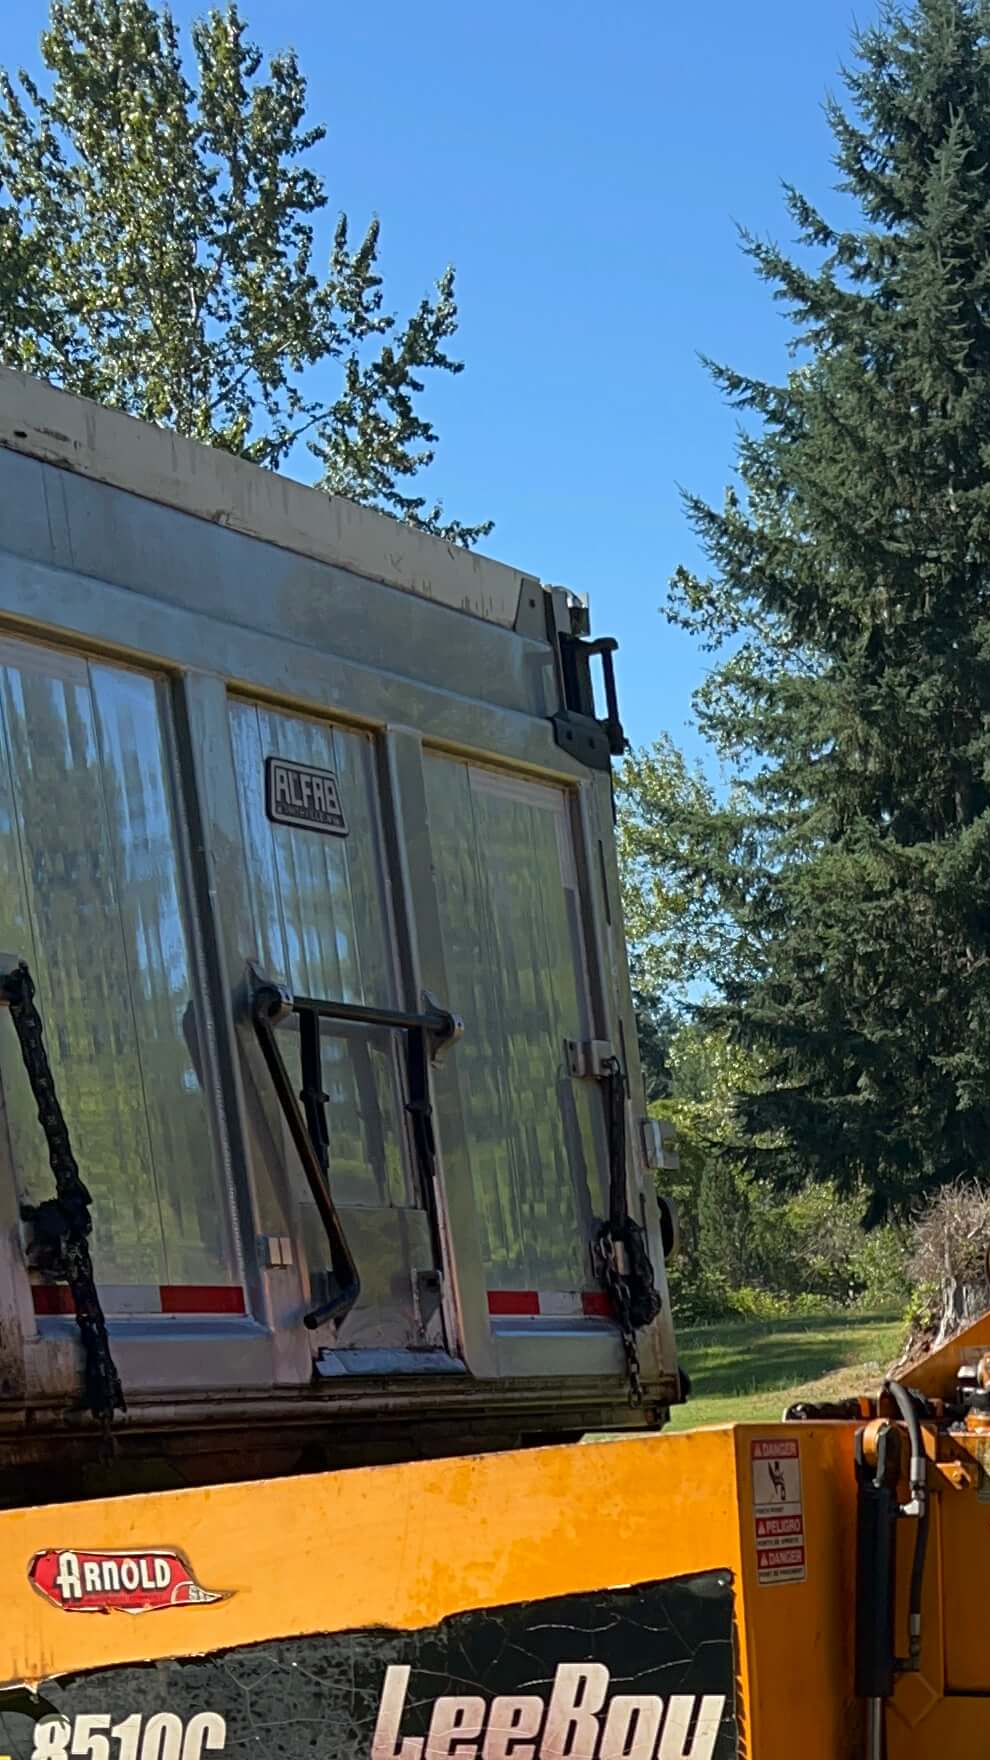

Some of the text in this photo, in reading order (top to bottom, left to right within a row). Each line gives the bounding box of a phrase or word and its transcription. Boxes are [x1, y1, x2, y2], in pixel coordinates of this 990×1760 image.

[275, 767, 341, 816] ALFAB
[762, 1442, 797, 1457] DANGER
[766, 1518, 801, 1534] PELIGRO
[768, 1549, 802, 1565] DANGER
